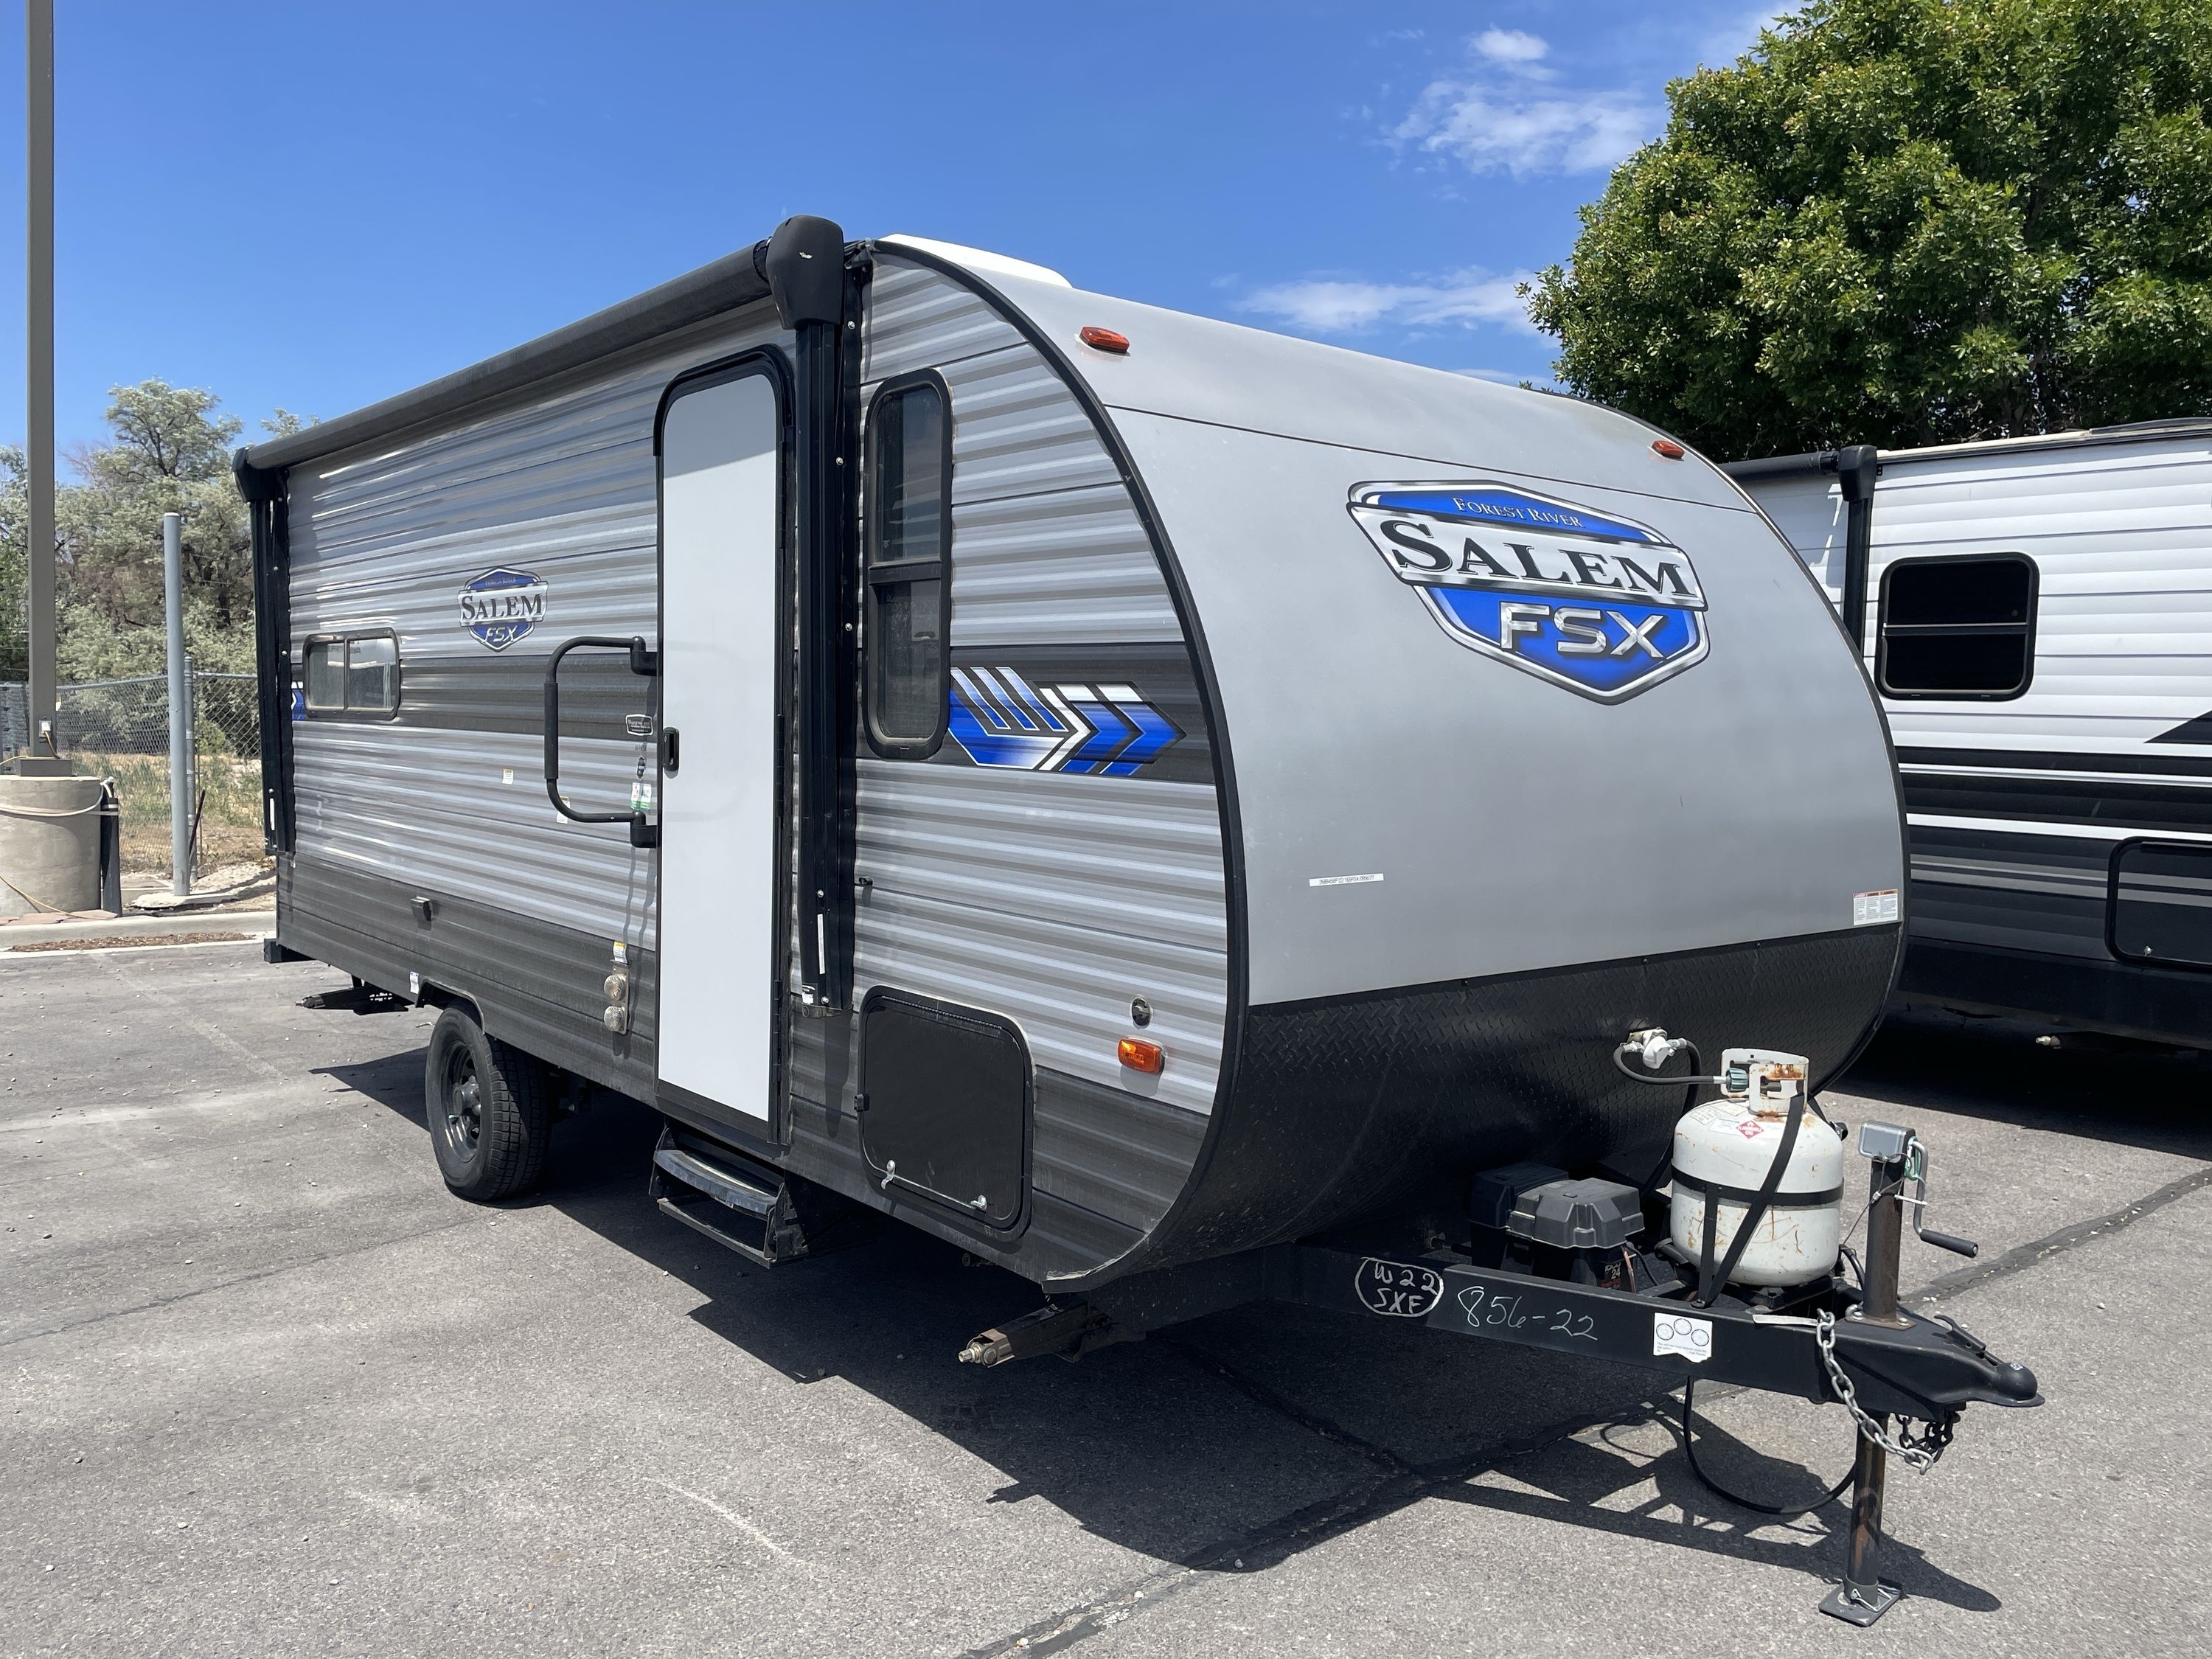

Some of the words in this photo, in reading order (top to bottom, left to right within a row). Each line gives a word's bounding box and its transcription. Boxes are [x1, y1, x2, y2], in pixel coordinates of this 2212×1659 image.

[1451, 497, 1526, 522] FOREST
[1529, 507, 1584, 528] RIVER
[1380, 519, 1698, 597] SALEM
[461, 594, 543, 619] SALEM
[485, 625, 518, 643] FSX
[1500, 601, 1665, 659] FSX
[1611, 1267, 1621, 1279] 24
[1457, 1286, 1598, 1341] 856-22
